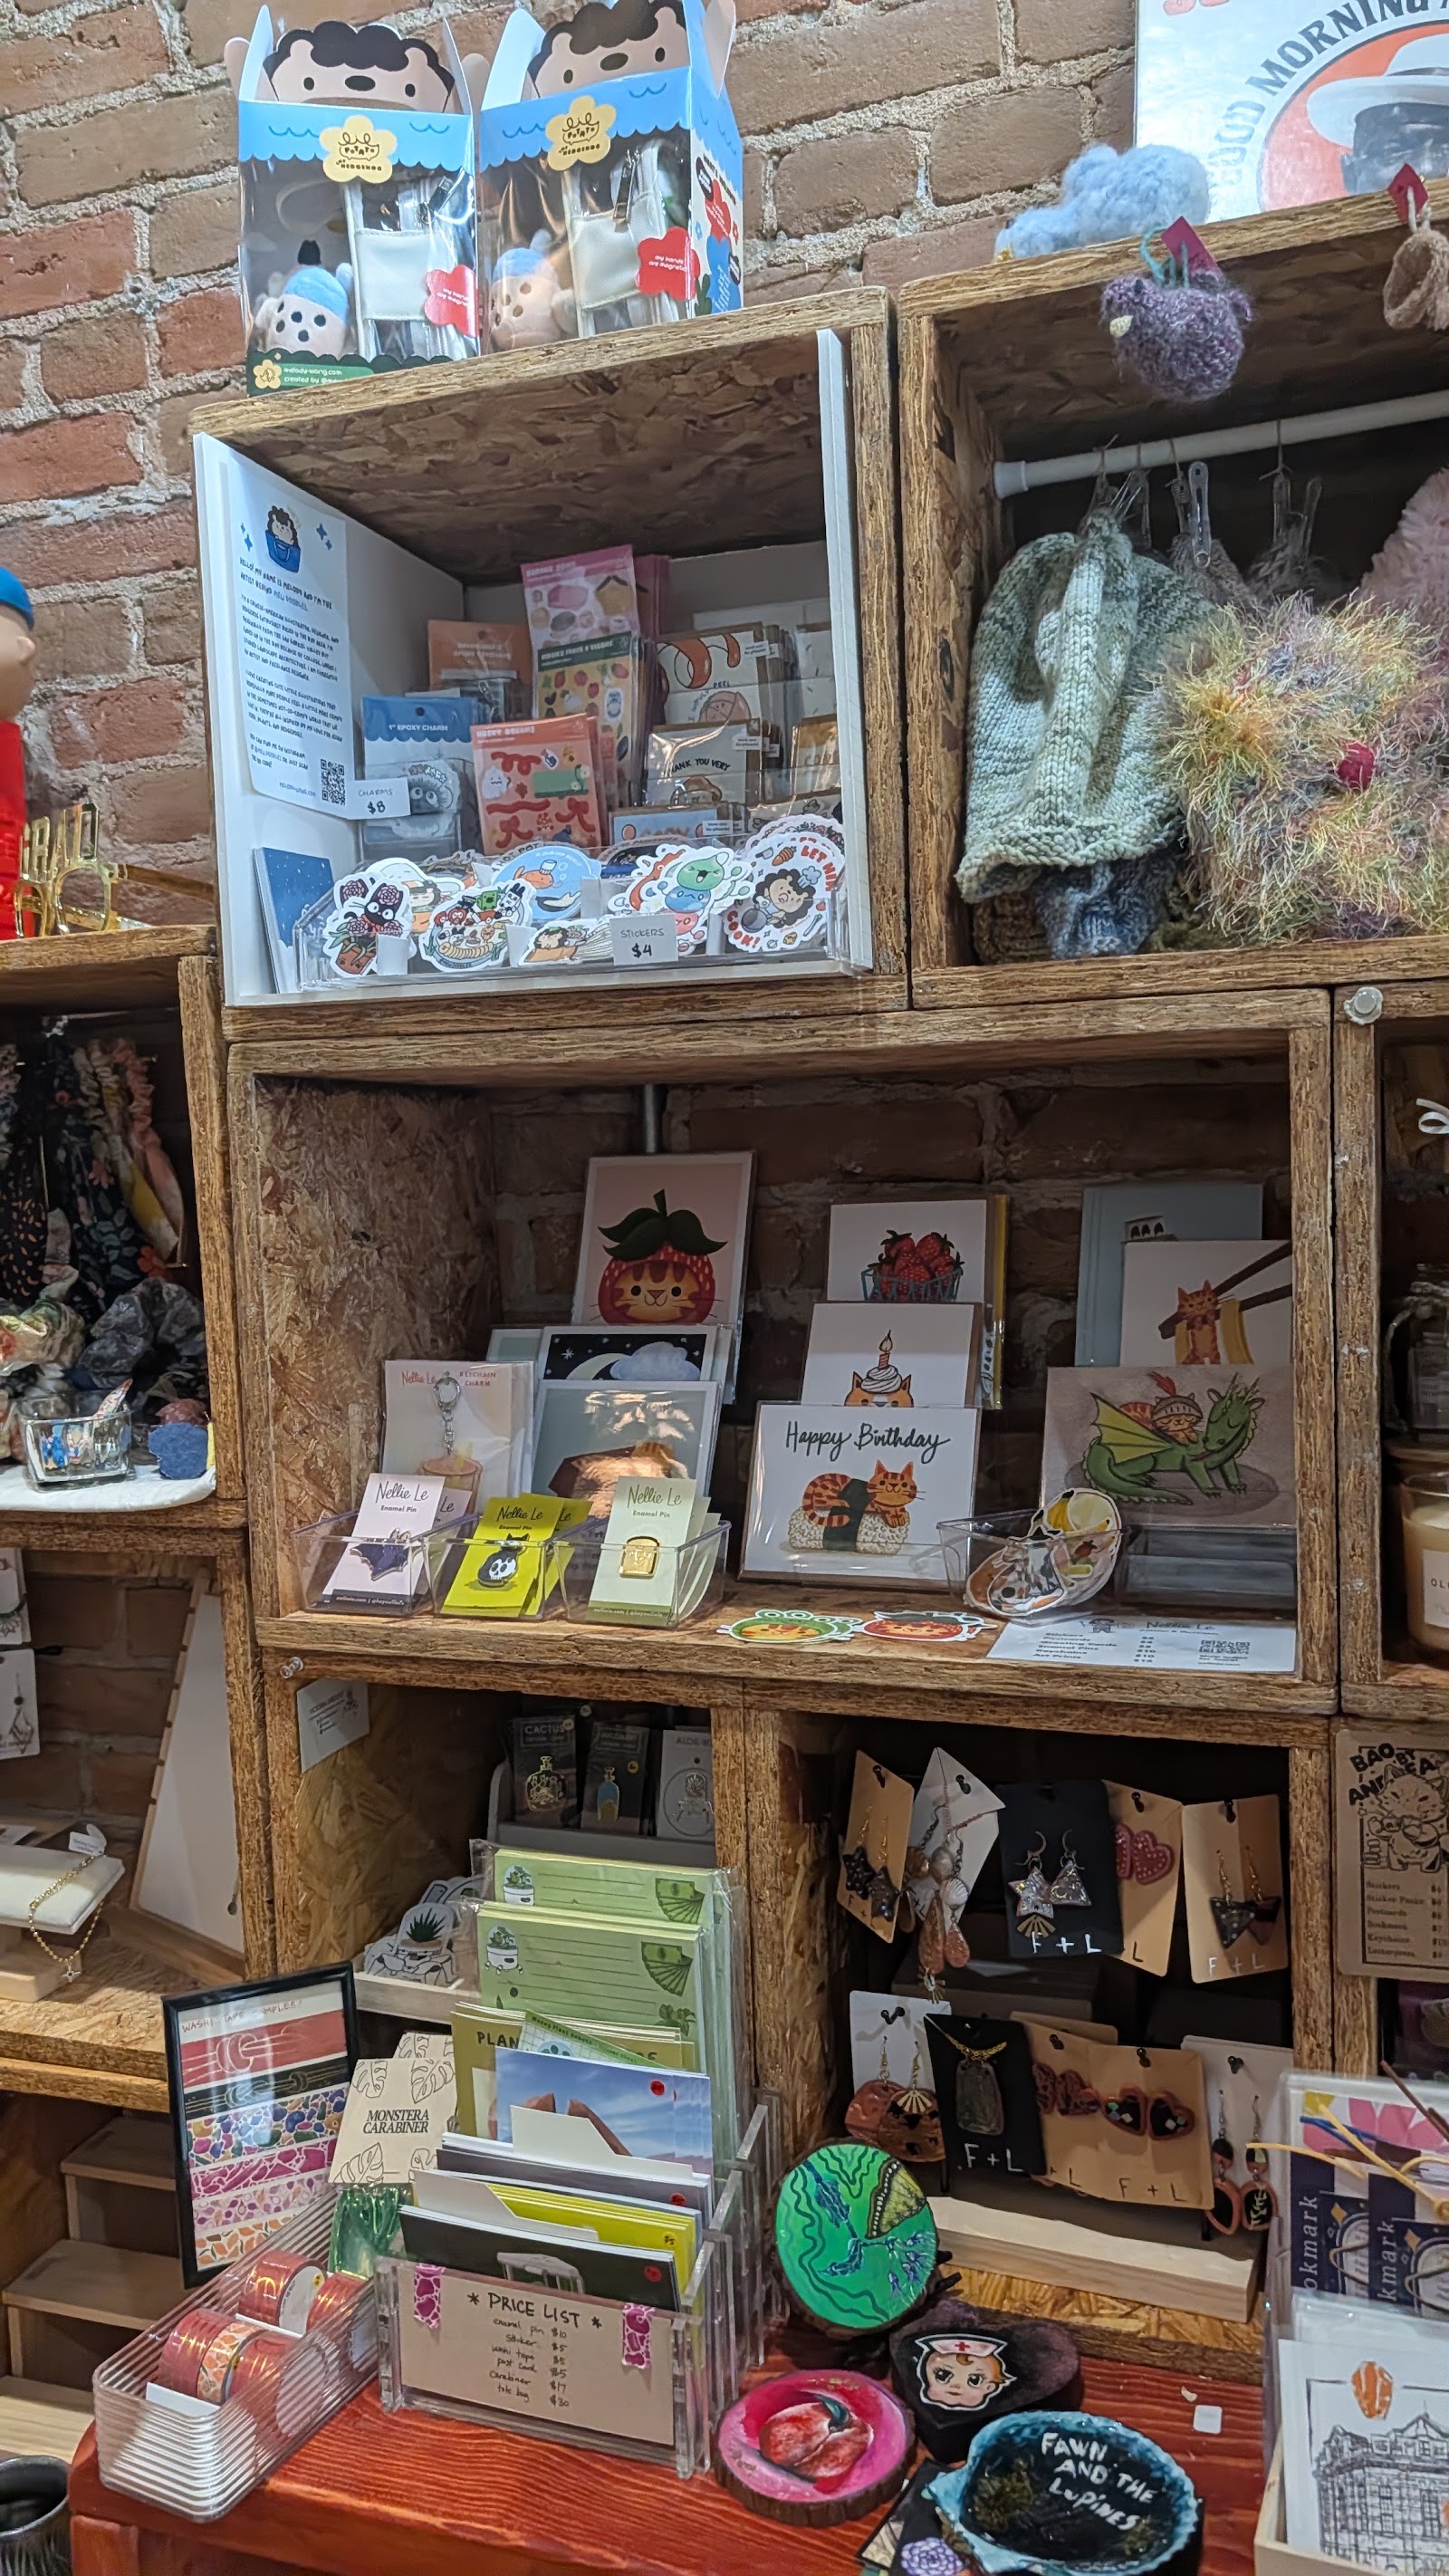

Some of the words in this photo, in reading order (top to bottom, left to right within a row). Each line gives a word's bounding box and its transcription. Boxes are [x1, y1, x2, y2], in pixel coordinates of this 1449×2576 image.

[1245, 0, 1429, 96] MORNING
[696, 757, 709, 766] YOU
[711, 759, 731, 772] VERY
[358, 788, 393, 797] CHARMS
[367, 801, 386, 815] $8
[801, 845, 827, 863] LET
[822, 861, 838, 892] HIM
[620, 928, 665, 938] STICKERS
[727, 909, 761, 949] COOK!
[631, 942, 652, 959] $4
[786, 1420, 852, 1462] Happy
[854, 1422, 951, 1465] Birthday
[375, 1481, 411, 1503] Nellie
[414, 1484, 428, 1501] Le
[627, 1485, 663, 1509] Nellie
[667, 1487, 682, 1506] Le
[439, 1496, 455, 1513] Le
[496, 1505, 528, 1523] Nellie
[530, 1507, 543, 1521] Le
[559, 1508, 571, 1522] Le
[524, 1725, 565, 1735] CACTUS
[1349, 1743, 1395, 1772] BAO
[1085, 1933, 1102, 1954] L
[1132, 1941, 1144, 1963] L
[1208, 1956, 1218, 1977] F
[1252, 1953, 1265, 1970] L
[181, 2019, 214, 2033] WASHI
[222, 2010, 245, 2023] TAPE
[366, 2109, 429, 2122] MONSTERA
[363, 2121, 428, 2134] CARABINER
[964, 2143, 979, 2168] F
[1006, 2148, 1023, 2172] L
[1069, 2167, 1081, 2187] L
[1118, 2177, 1130, 2198] F
[1170, 2183, 1185, 2202] L
[487, 2292, 535, 2317] PRICE
[543, 2303, 581, 2329] LIST
[493, 2317, 522, 2329] enamel
[530, 2325, 544, 2336] pin
[552, 2327, 567, 2339] $10
[552, 2342, 568, 2352] $5
[552, 2355, 566, 2365] $5
[550, 2367, 567, 2379] $5
[550, 2381, 567, 2393] $17
[549, 2395, 570, 2408] $30
[1041, 2432, 1108, 2462] FAWN
[1053, 2458, 1108, 2485] AND
[1117, 2473, 1157, 2504] THE
